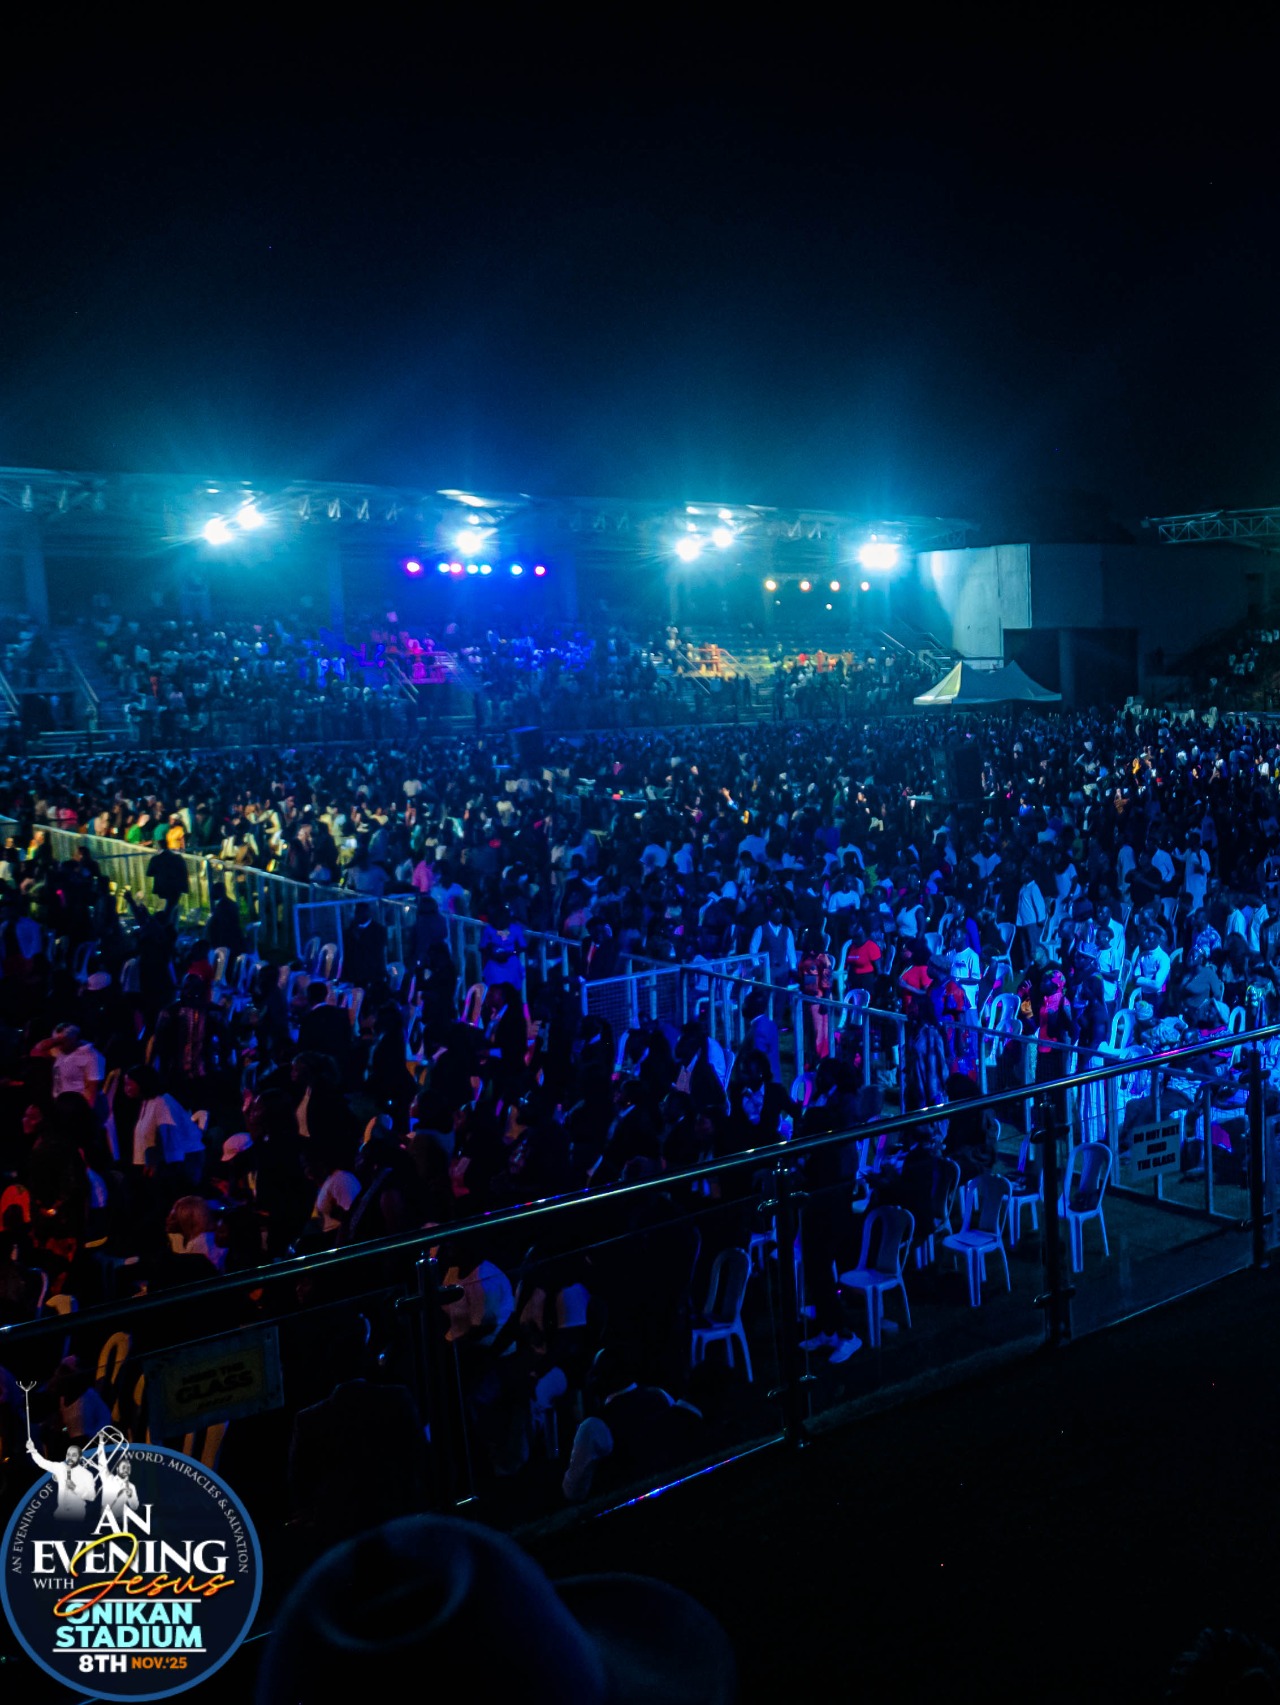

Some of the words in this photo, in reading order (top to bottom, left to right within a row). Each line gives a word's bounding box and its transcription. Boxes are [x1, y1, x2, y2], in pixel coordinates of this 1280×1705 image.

[1146, 1130, 1160, 1140] NOT
[1162, 1125, 1179, 1137] REST
[1138, 1159, 1150, 1171] THE
[1152, 1153, 1175, 1167] GLASS
[220, 1362, 244, 1375] THE
[176, 1370, 253, 1403] GLASS
